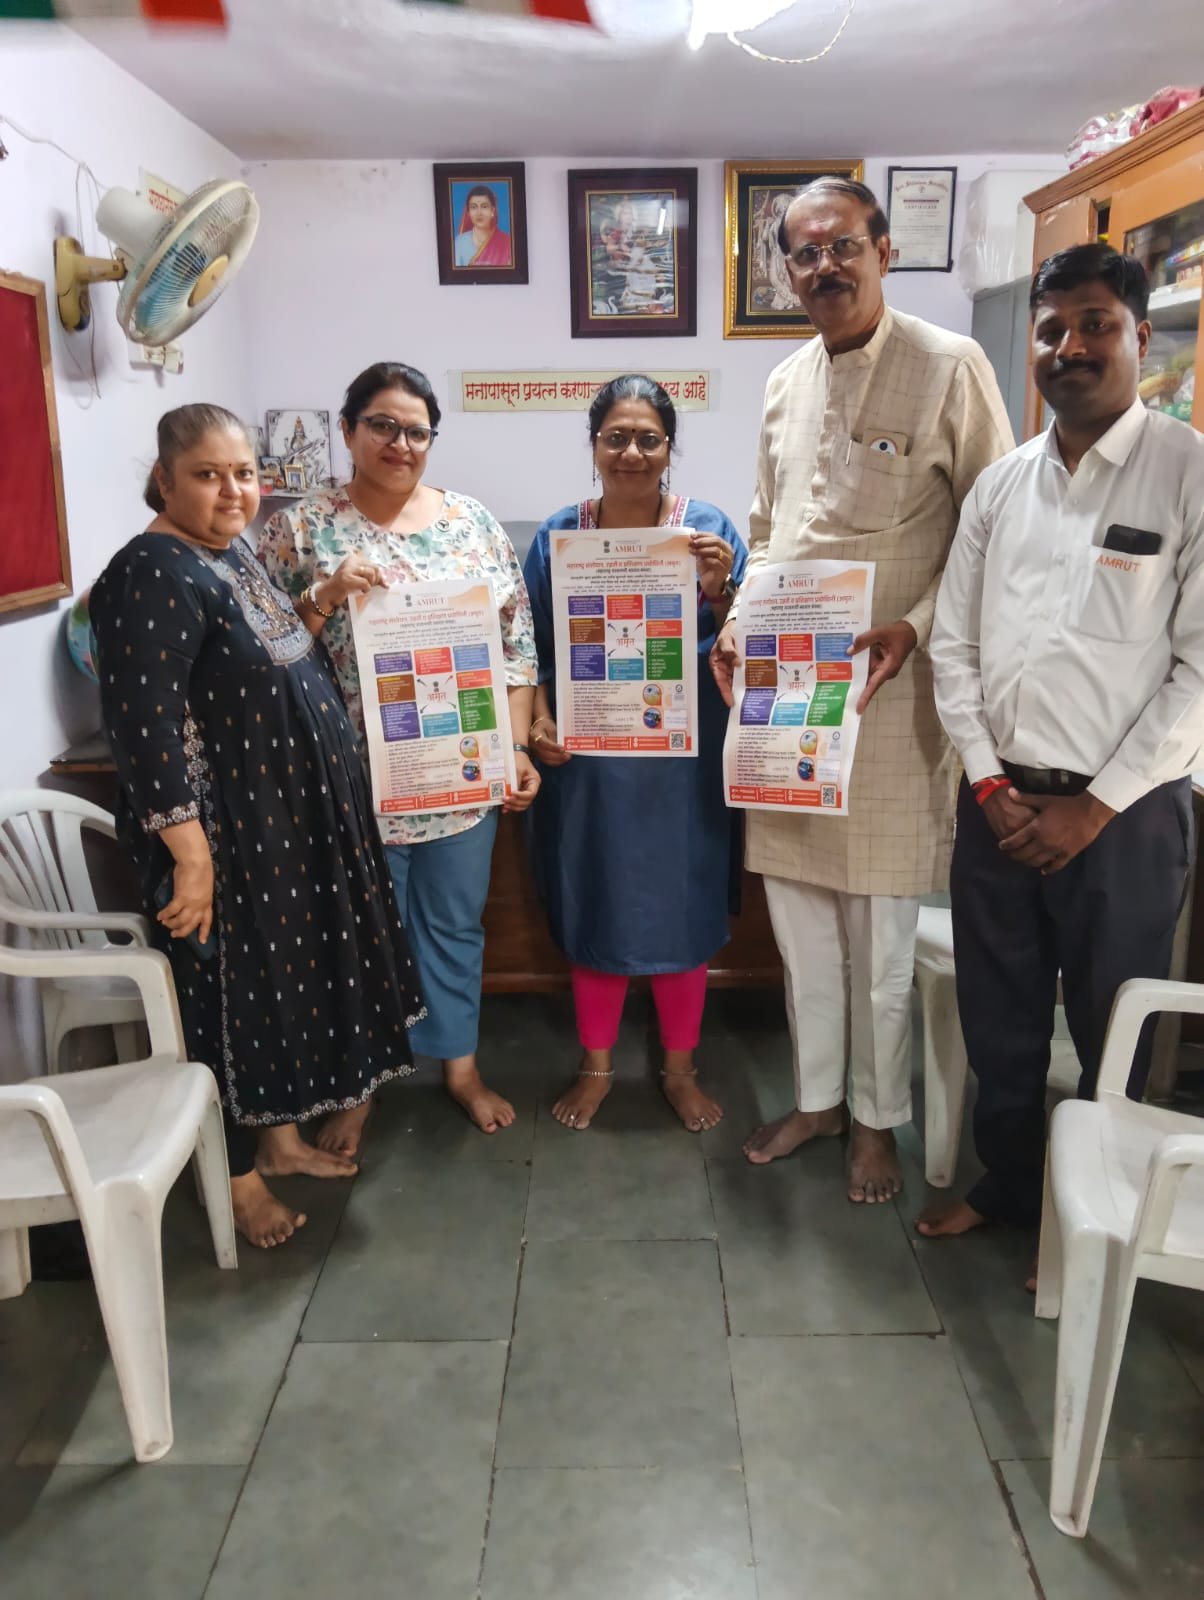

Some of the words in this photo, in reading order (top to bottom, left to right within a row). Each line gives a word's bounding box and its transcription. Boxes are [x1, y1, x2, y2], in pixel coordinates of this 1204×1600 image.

[465, 382, 520, 407] मनापासून
[523, 382, 557, 401] प्रयत्न
[683, 375, 706, 401] आहे
[1096, 554, 1141, 572] AMRUT
